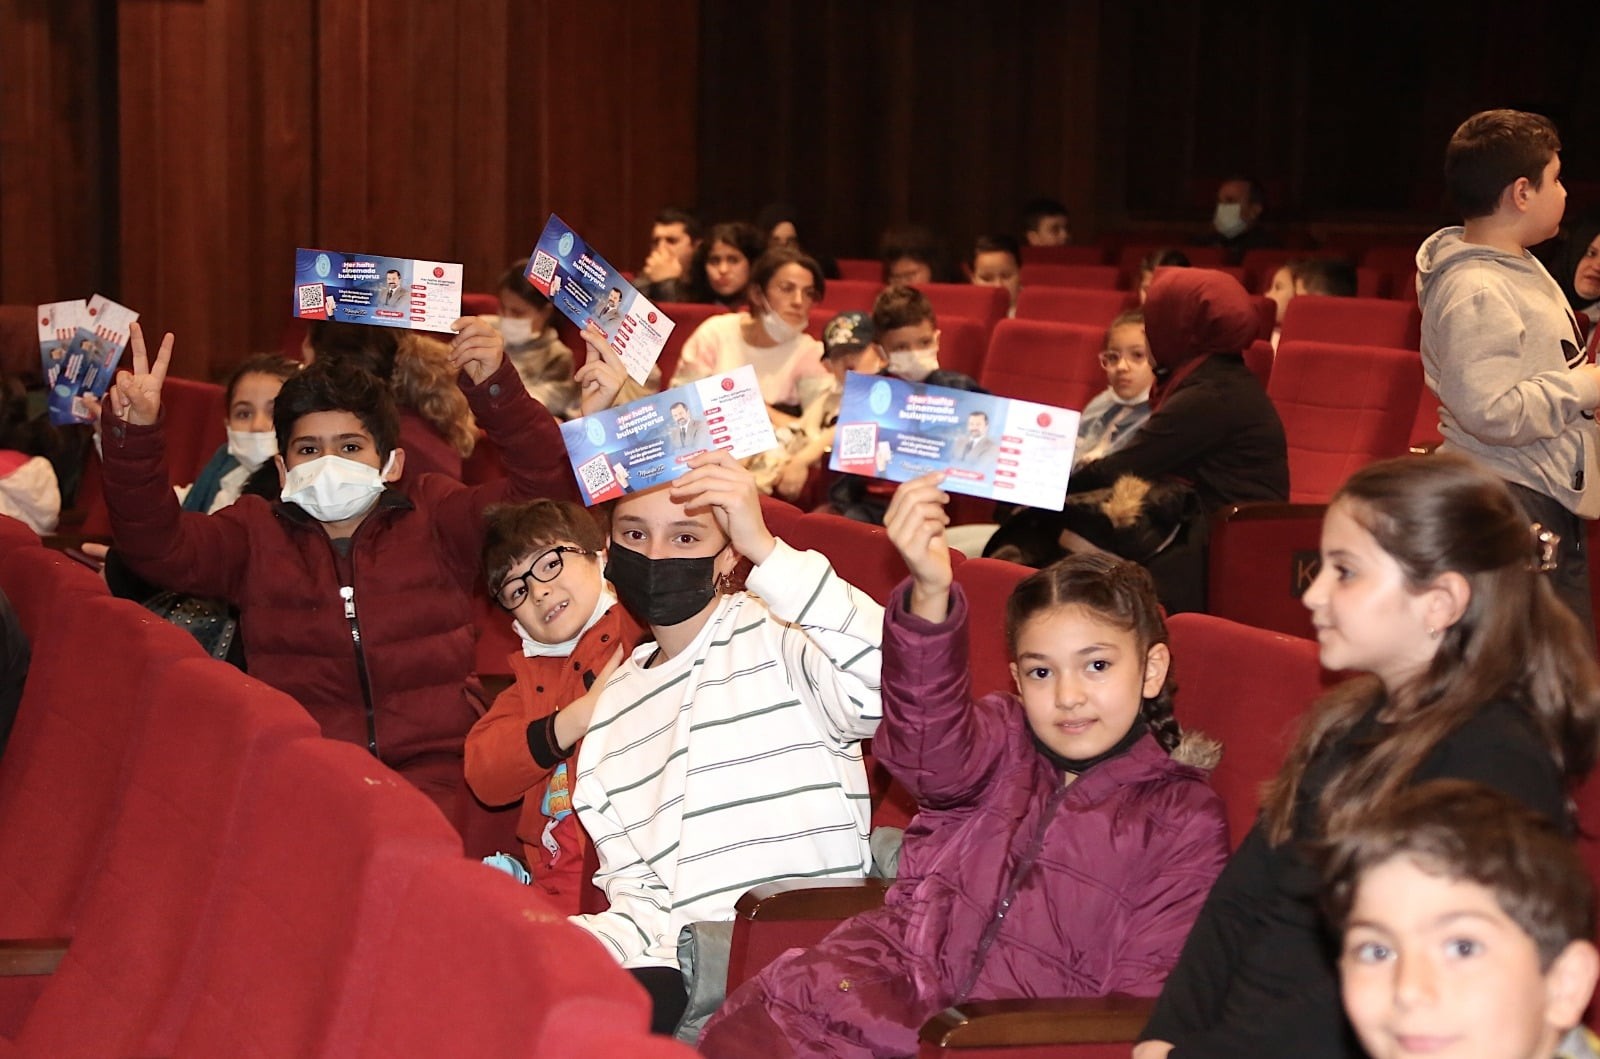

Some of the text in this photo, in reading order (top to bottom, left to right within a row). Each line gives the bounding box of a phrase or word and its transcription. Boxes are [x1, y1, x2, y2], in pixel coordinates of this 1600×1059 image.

[578, 259, 605, 282] sinemada
[619, 411, 657, 430] sinemada
[1297, 560, 1318, 589] K
